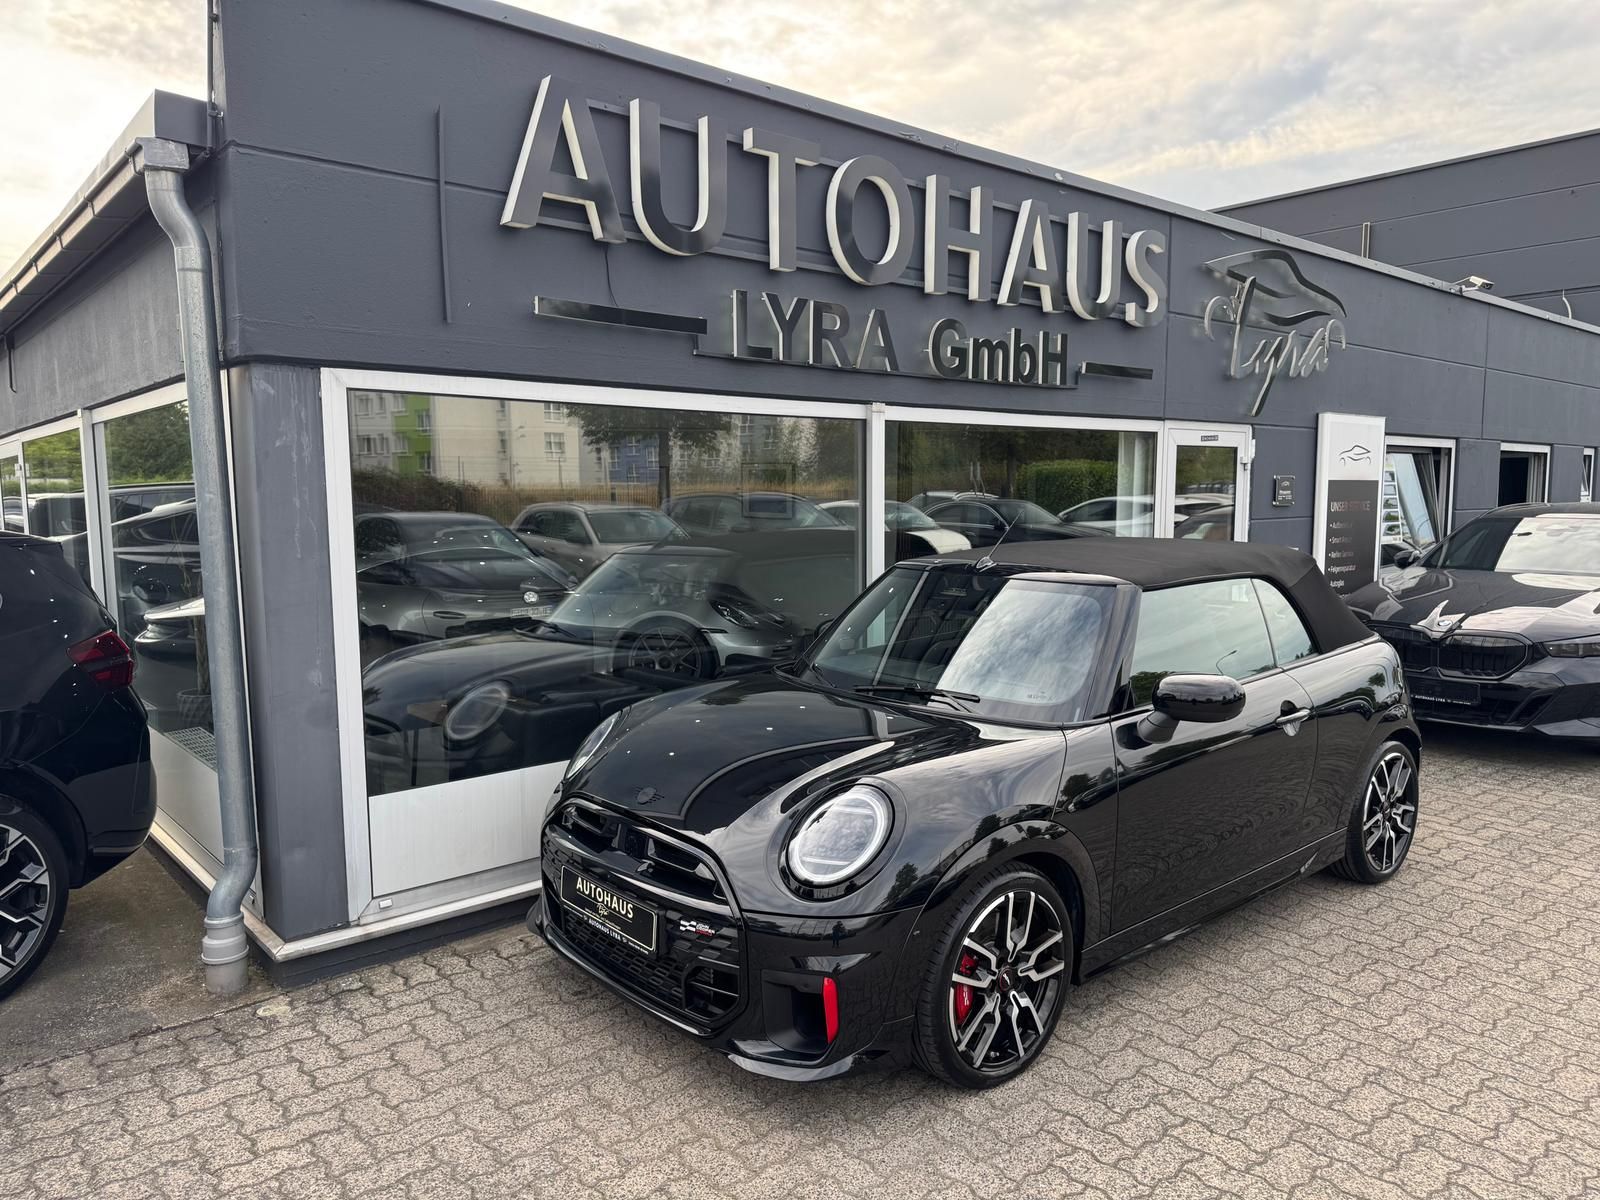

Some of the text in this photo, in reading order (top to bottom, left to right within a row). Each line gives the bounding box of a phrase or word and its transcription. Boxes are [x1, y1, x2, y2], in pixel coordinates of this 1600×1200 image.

[500, 74, 1167, 328] AUTOHAUS
[730, 288, 1069, 387] LYRA GmbH
[576, 877, 634, 918] AUTOHAUS
[588, 918, 610, 934] AUTOHAUS
[610, 930, 622, 942] LYRA
